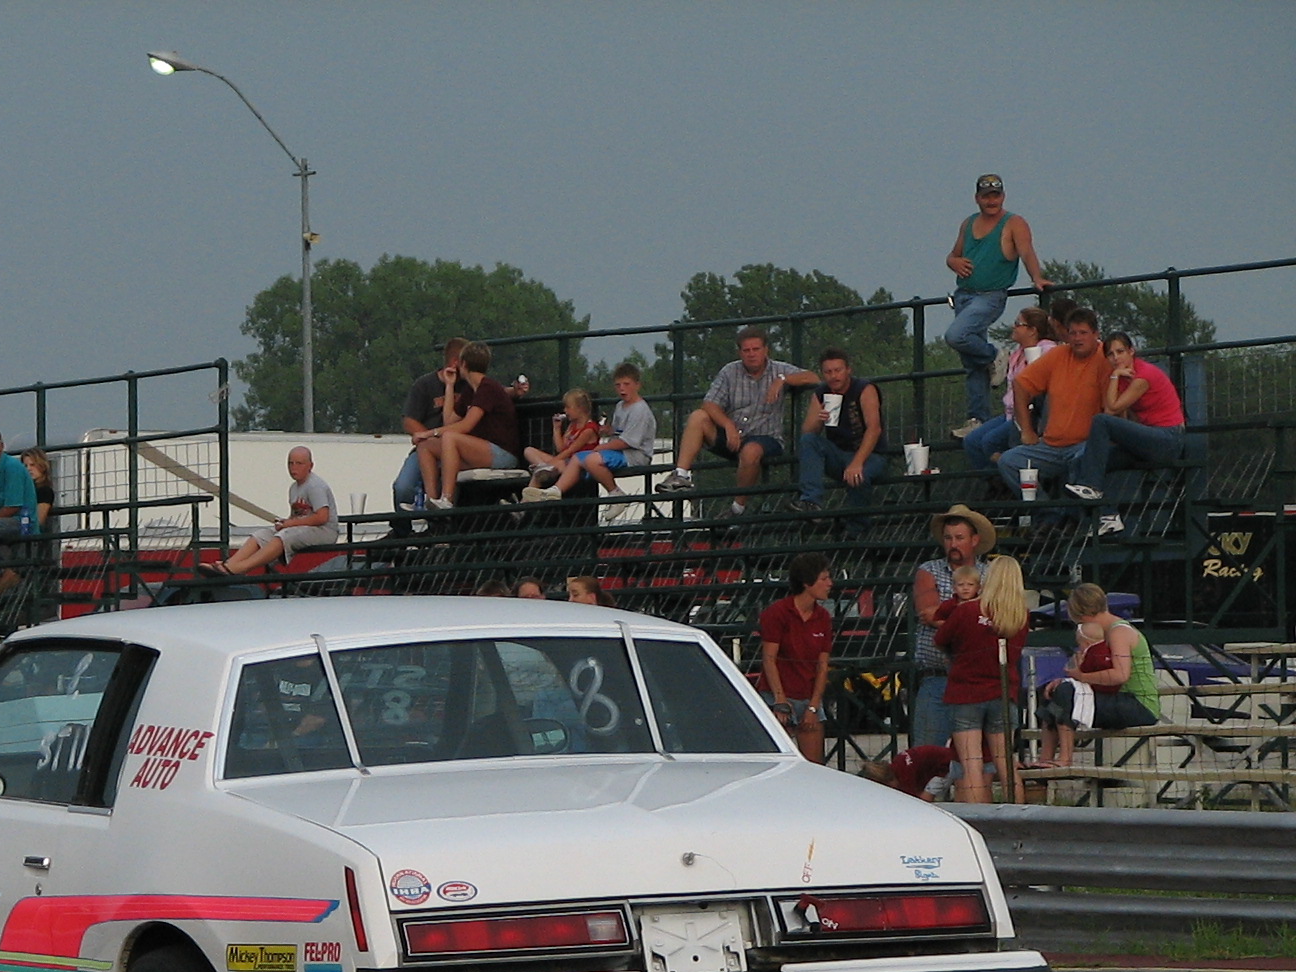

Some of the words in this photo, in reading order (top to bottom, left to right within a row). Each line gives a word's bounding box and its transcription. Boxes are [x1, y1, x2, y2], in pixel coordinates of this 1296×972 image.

[569, 655, 620, 734] 8
[127, 724, 216, 762] ADVANCE
[129, 758, 182, 791] AUTO
[228, 946, 259, 970] Mickey
[259, 946, 295, 963] Thompson
